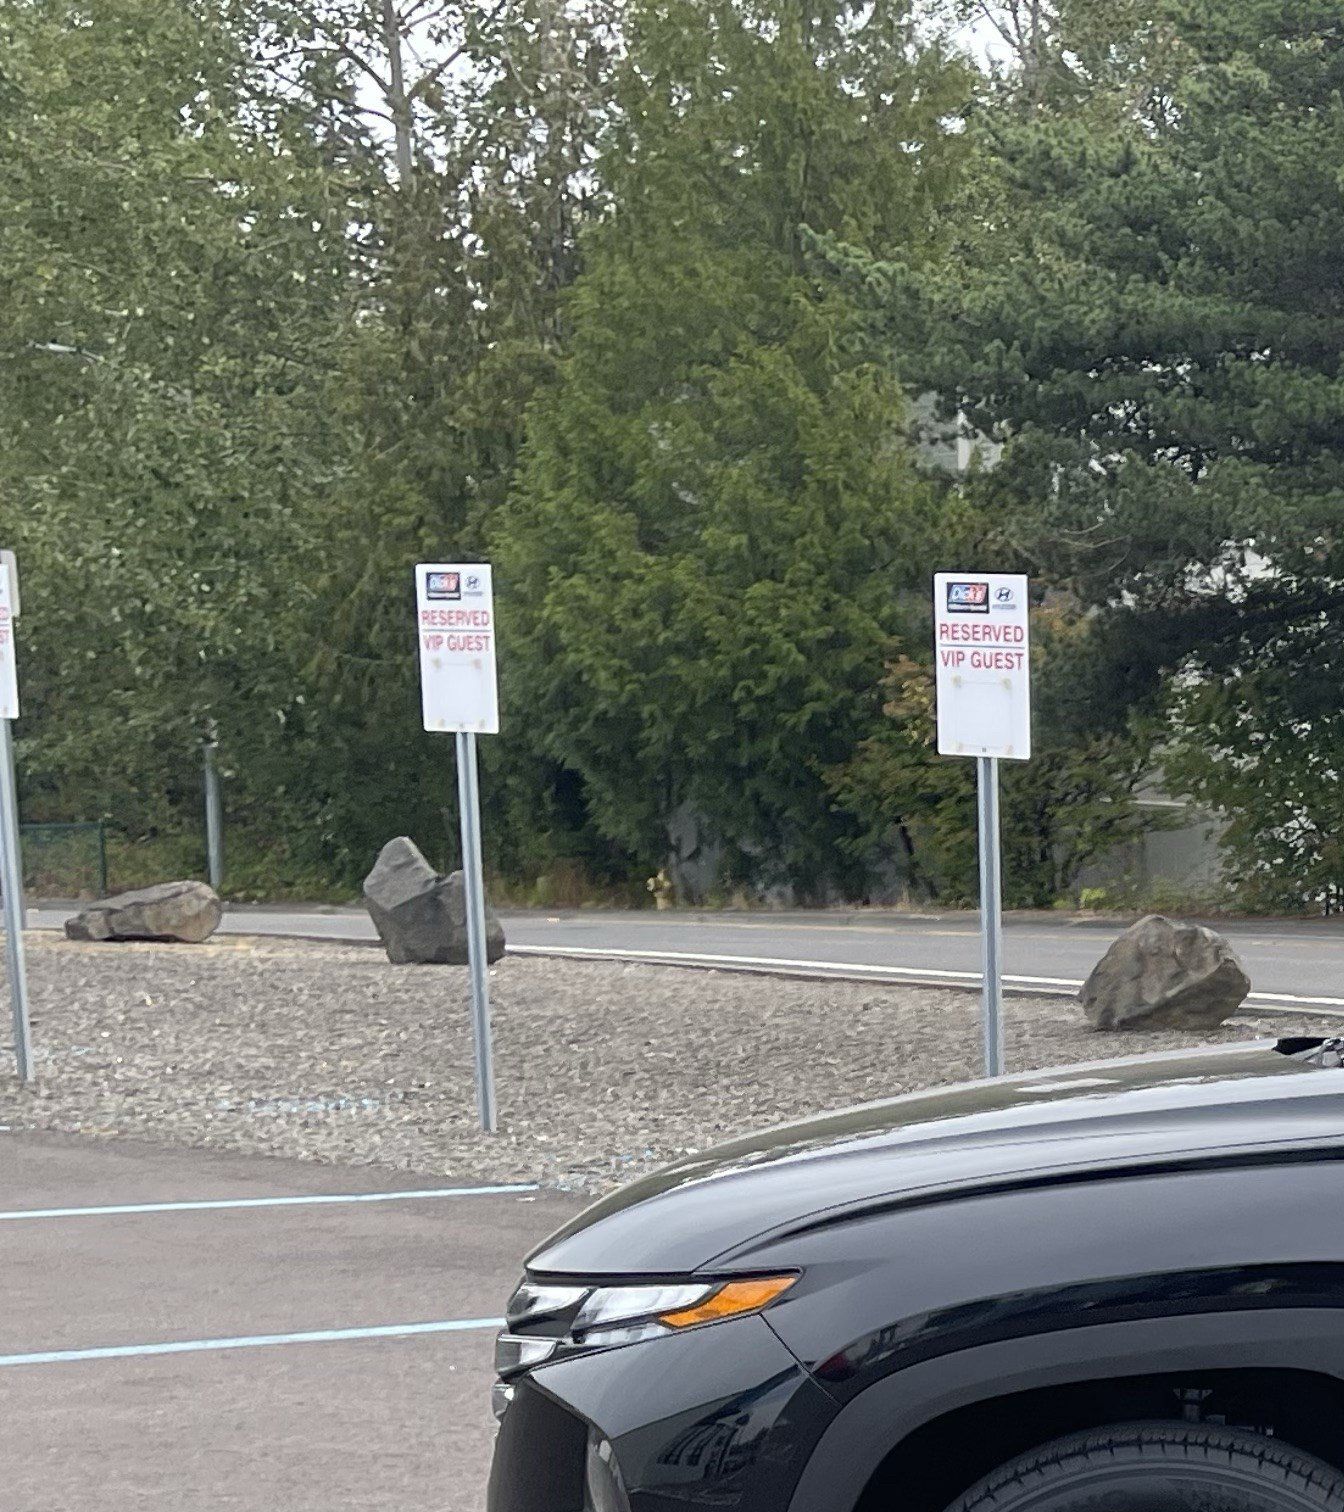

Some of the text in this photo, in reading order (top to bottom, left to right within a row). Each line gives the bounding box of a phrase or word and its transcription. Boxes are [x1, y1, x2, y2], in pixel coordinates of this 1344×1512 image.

[421, 609, 491, 627] RESERVED
[939, 623, 1025, 643] RESERVED
[423, 634, 491, 652] VIP GUEST
[941, 650, 1024, 670] VIP GUEST
